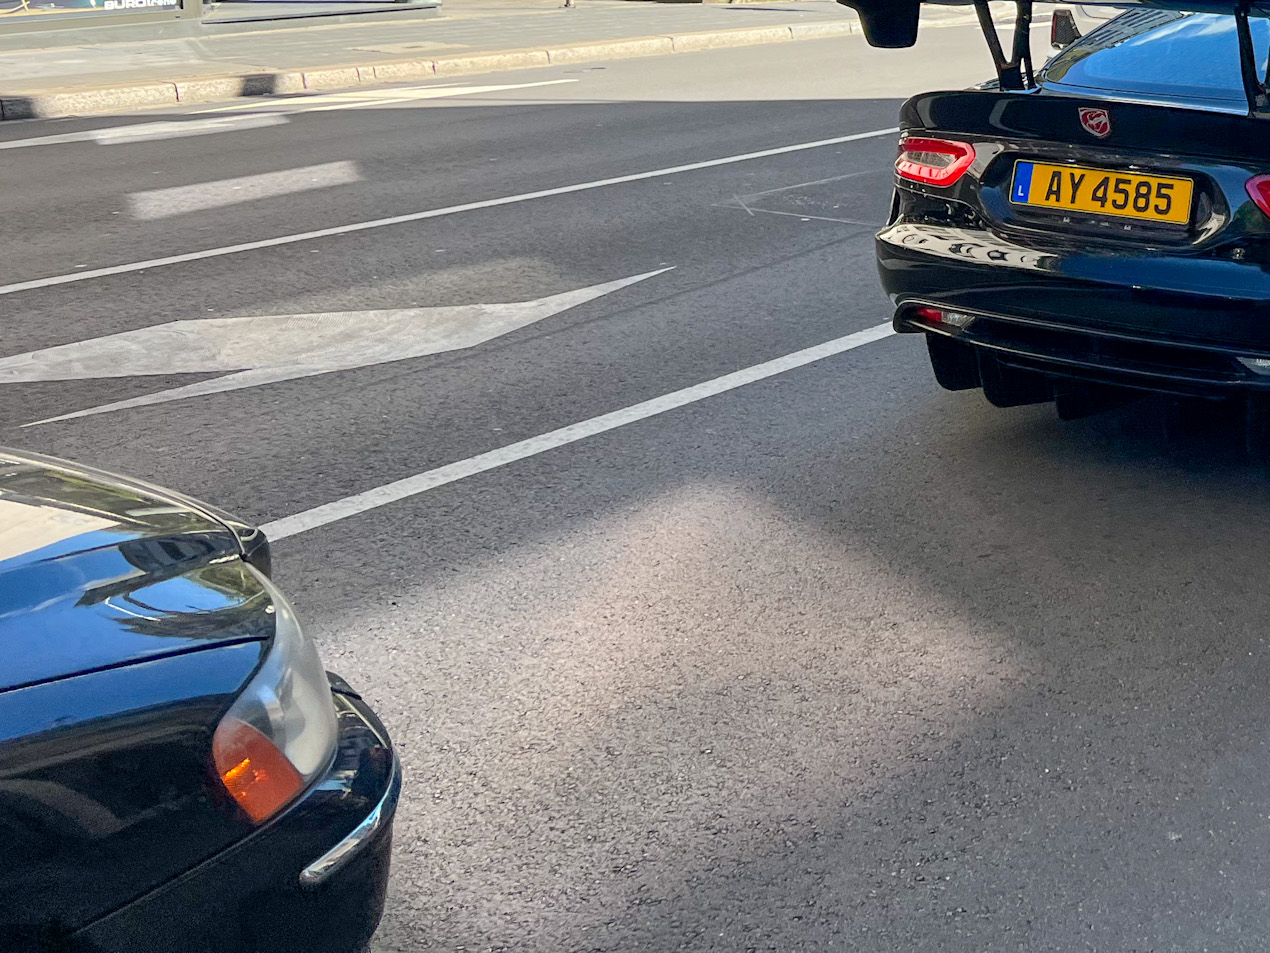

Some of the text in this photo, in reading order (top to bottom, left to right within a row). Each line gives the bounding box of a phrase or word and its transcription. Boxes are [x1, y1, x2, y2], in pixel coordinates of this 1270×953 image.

[1017, 170, 1175, 215] L AY 4585
